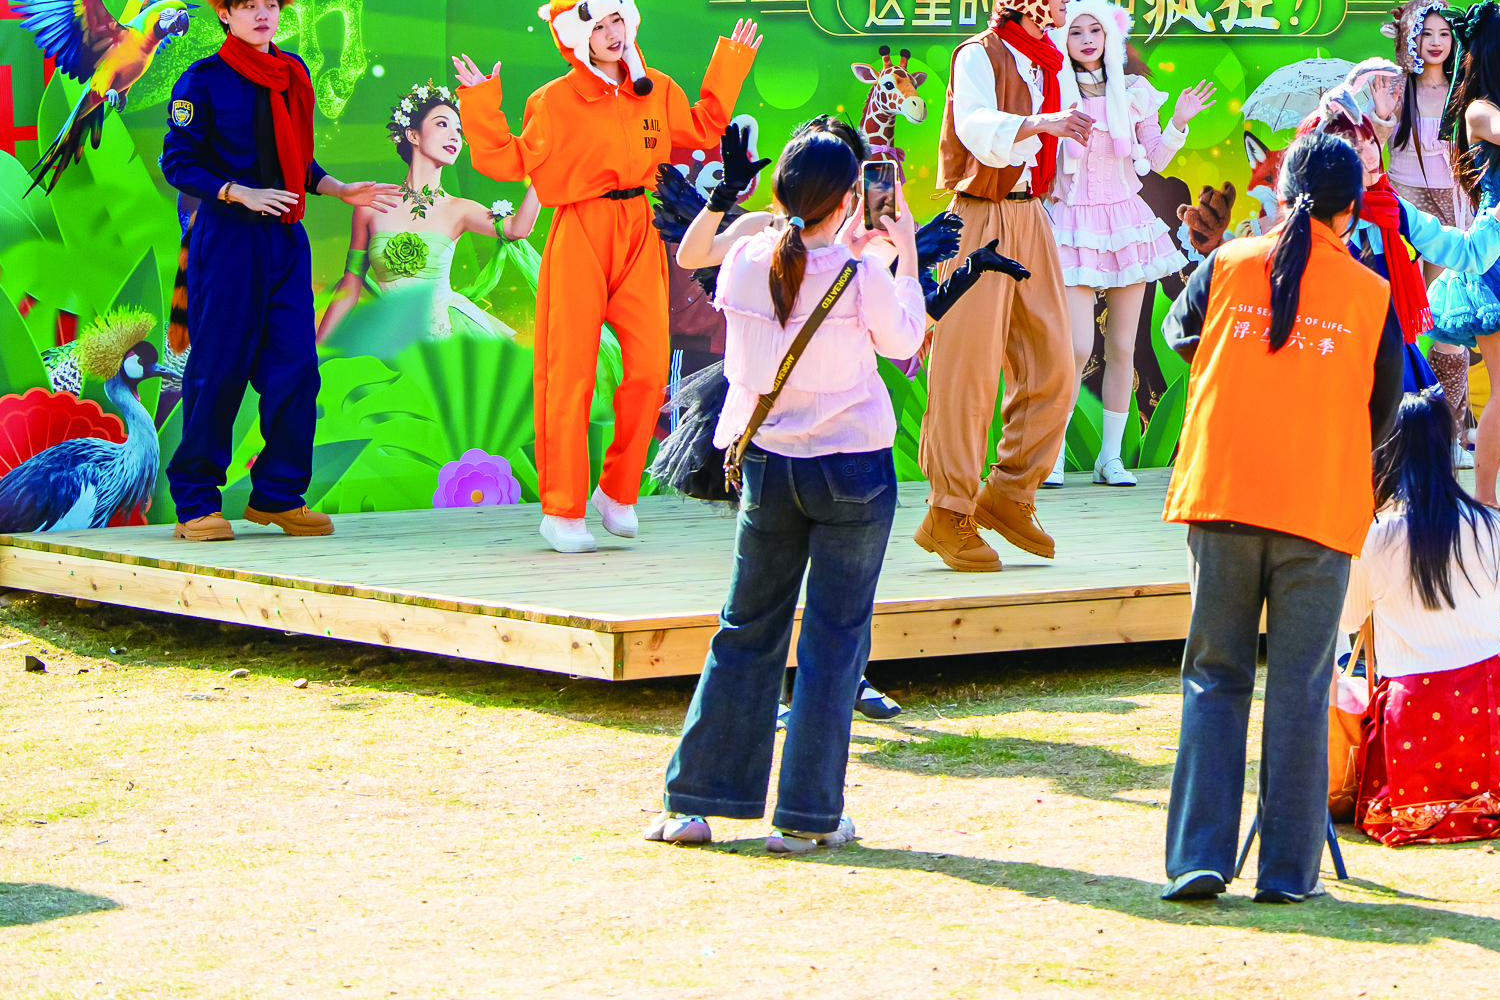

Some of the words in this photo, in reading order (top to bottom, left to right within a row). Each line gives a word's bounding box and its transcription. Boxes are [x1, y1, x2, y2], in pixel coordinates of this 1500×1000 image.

[643, 118, 661, 132] JAIL
[1238, 304, 1254, 314] SIX
[1304, 316, 1319, 326] OF
[1321, 320, 1343, 332] LIFE
